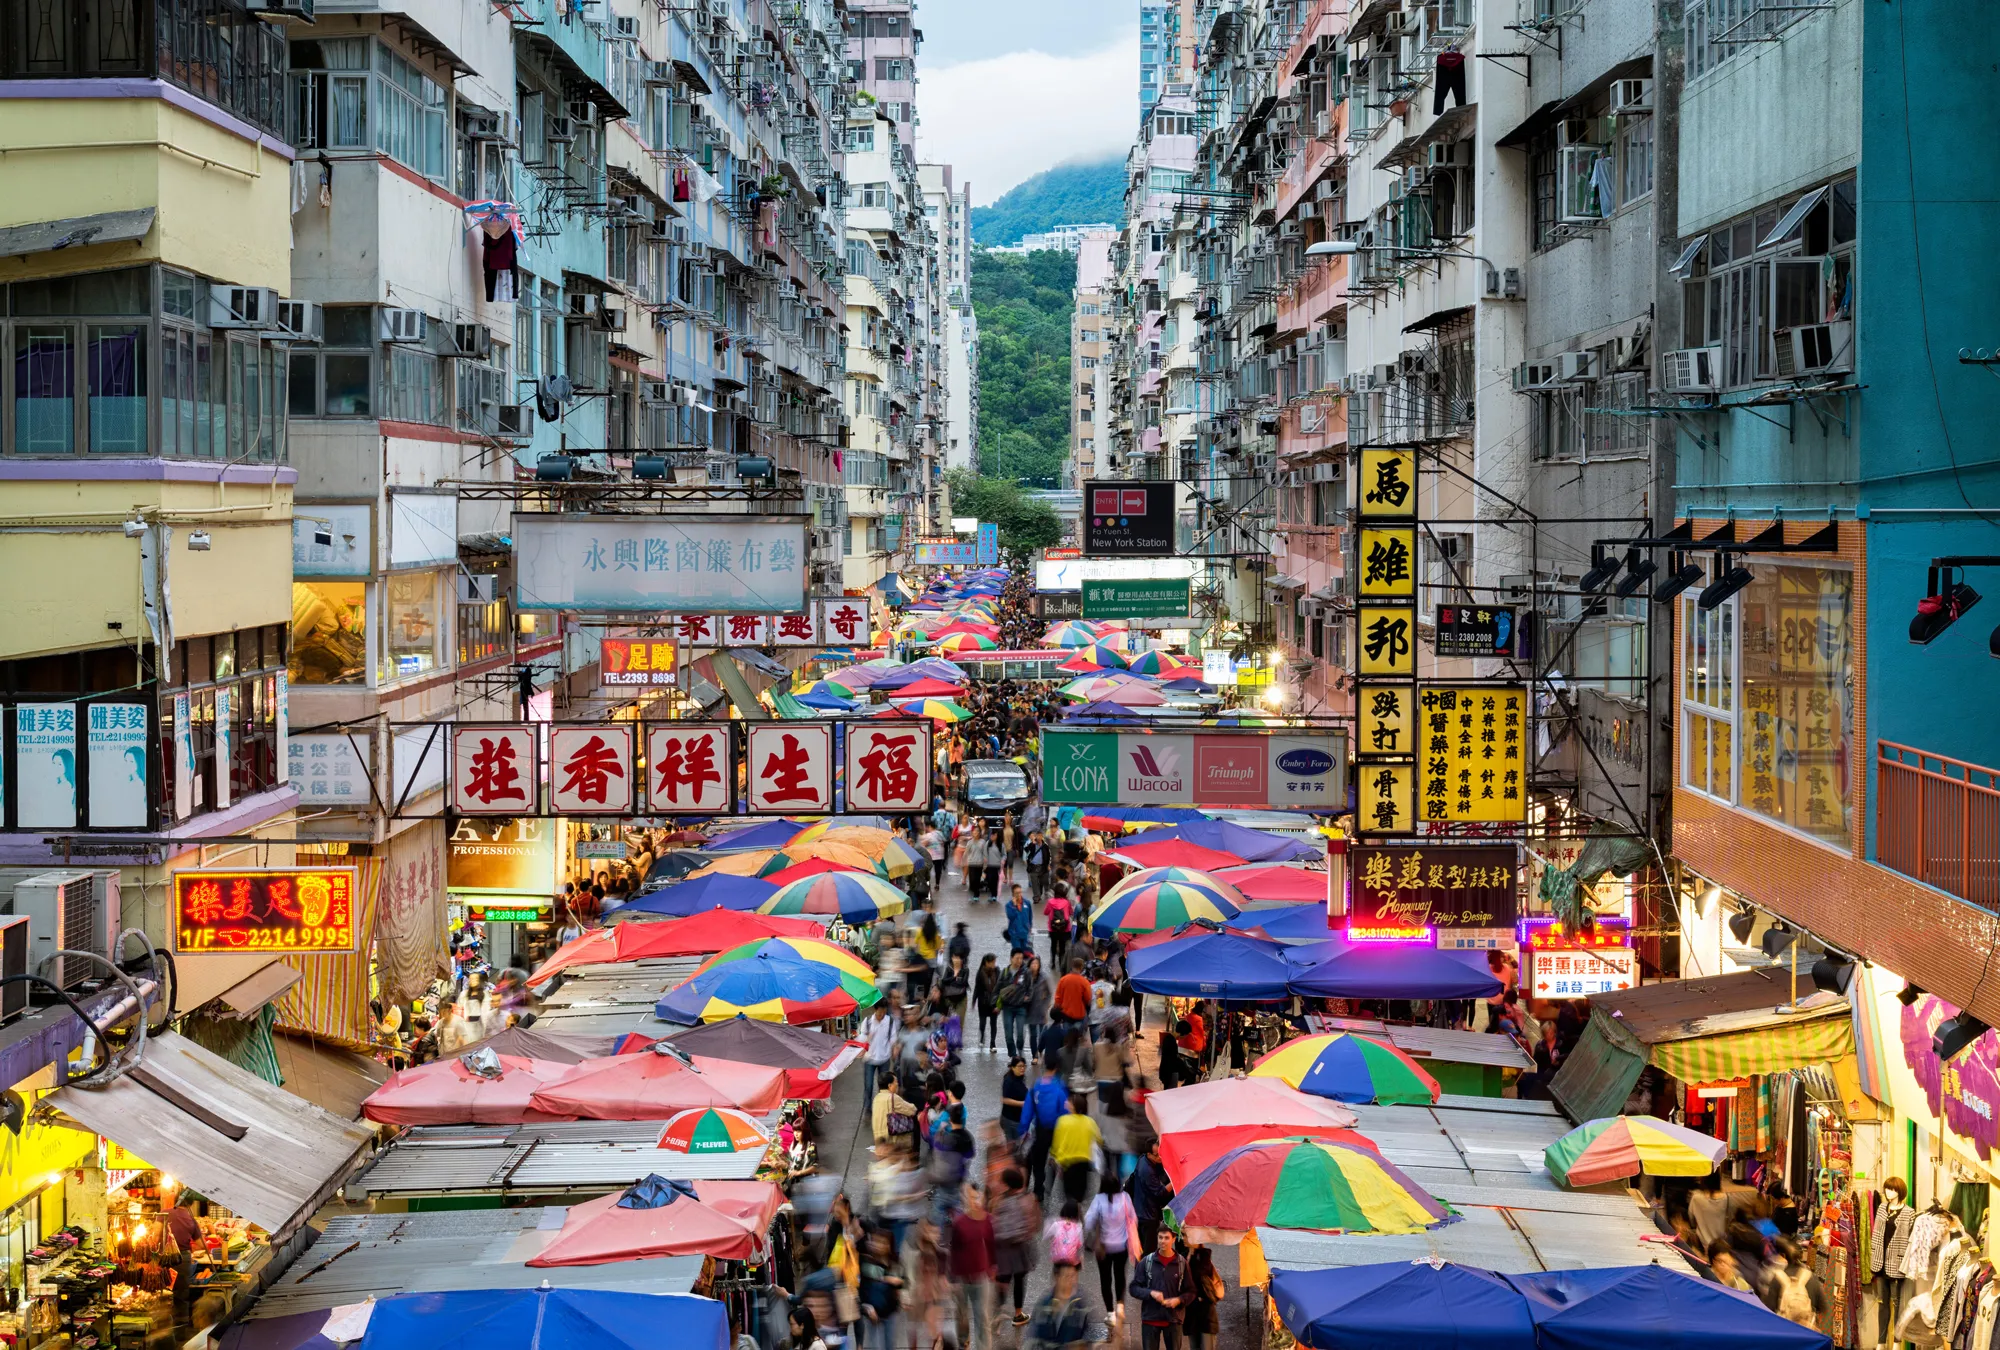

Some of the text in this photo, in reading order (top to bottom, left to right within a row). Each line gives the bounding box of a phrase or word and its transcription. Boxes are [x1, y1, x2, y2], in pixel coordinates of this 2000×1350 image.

[1092, 538, 1168, 547] New York Station
[581, 537, 796, 573] 永興隆窗簾布藝
[1458, 633, 1475, 642] 2380
[1475, 634, 1492, 642] 2008
[627, 642, 675, 671] 足跡
[603, 672, 676, 684] TEL:2393 8698
[18, 708, 75, 732] 雅美姿
[90, 706, 145, 730] 雅美姿
[17, 734, 75, 745] TEL:22149995
[89, 732, 146, 742] TEL:22149995
[1457, 696, 1473, 814] 中醫全科 骨傷科
[1480, 696, 1496, 800] 治脊推拿 針灸
[1281, 759, 1331, 769] Embry Form
[1053, 765, 1109, 792] LEONA
[1207, 765, 1254, 780] Triumph
[1128, 778, 1182, 792] Wacoal
[1286, 782, 1325, 792] 安莉芳
[453, 846, 538, 856] PROFESSIONAL
[1432, 910, 1494, 927] Hair Design
[181, 928, 216, 948] 1/F
[1555, 980, 1613, 993] 請登二樓
[114, 1145, 125, 1160] 房
